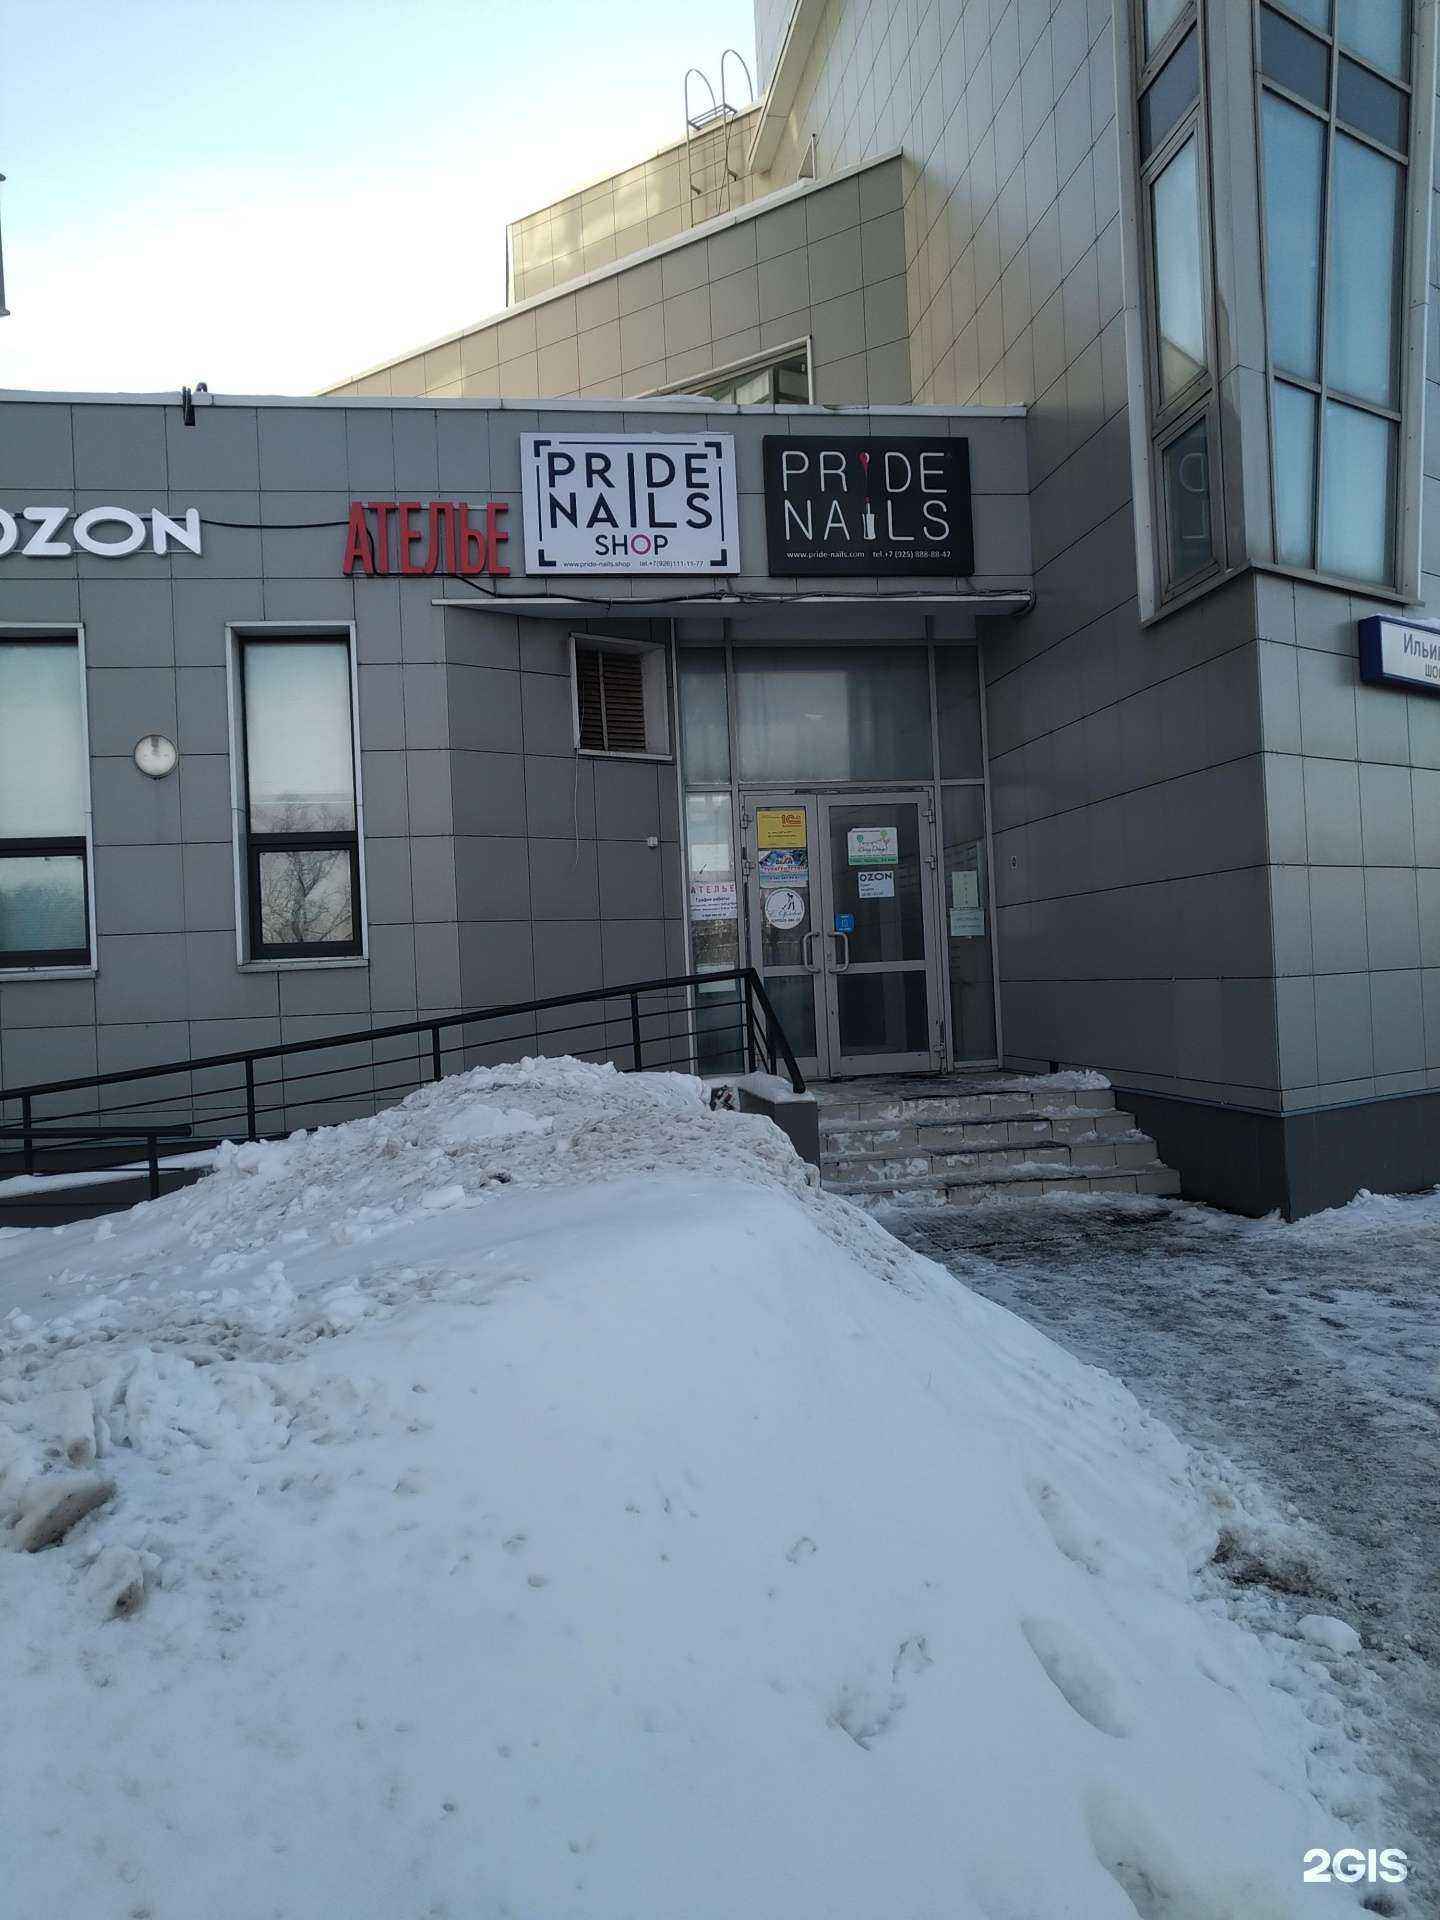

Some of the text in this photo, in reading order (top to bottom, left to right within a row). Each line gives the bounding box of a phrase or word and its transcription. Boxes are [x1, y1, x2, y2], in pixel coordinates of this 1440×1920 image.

[547, 451, 710, 489] PRIDE
[782, 450, 948, 493] PRIDE
[548, 491, 713, 530] NAILS
[784, 498, 950, 541] NAILS
[0, 506, 202, 558] ZON
[342, 501, 511, 576] АТЕЛЬЕ
[595, 534, 669, 556] SHOP
[563, 561, 631, 570] www.pride-nails.shop
[786, 550, 865, 560] www.pride-nails.com
[690, 883, 735, 894] АТЕЛЬЕ
[859, 872, 892, 882] OZON
